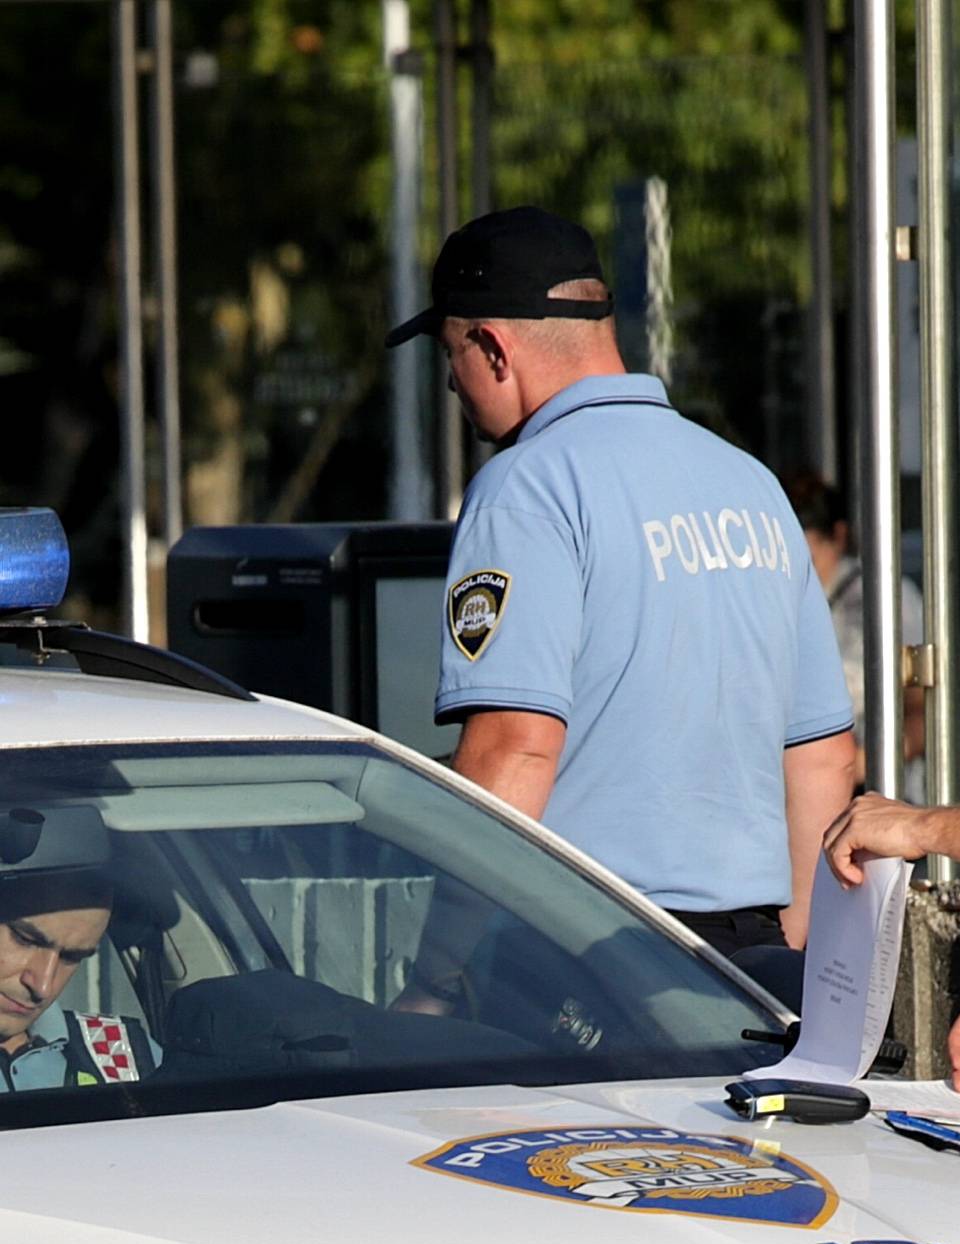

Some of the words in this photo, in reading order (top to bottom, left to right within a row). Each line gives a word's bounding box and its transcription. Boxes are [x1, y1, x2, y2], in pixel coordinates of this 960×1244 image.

[642, 508, 791, 582] POLICIJA
[454, 574, 506, 598] POLICIJA
[465, 601, 487, 616] RH
[443, 1127, 738, 1169] POLICIJA
[583, 1151, 719, 1178] RH
[625, 1170, 760, 1190] MUP
